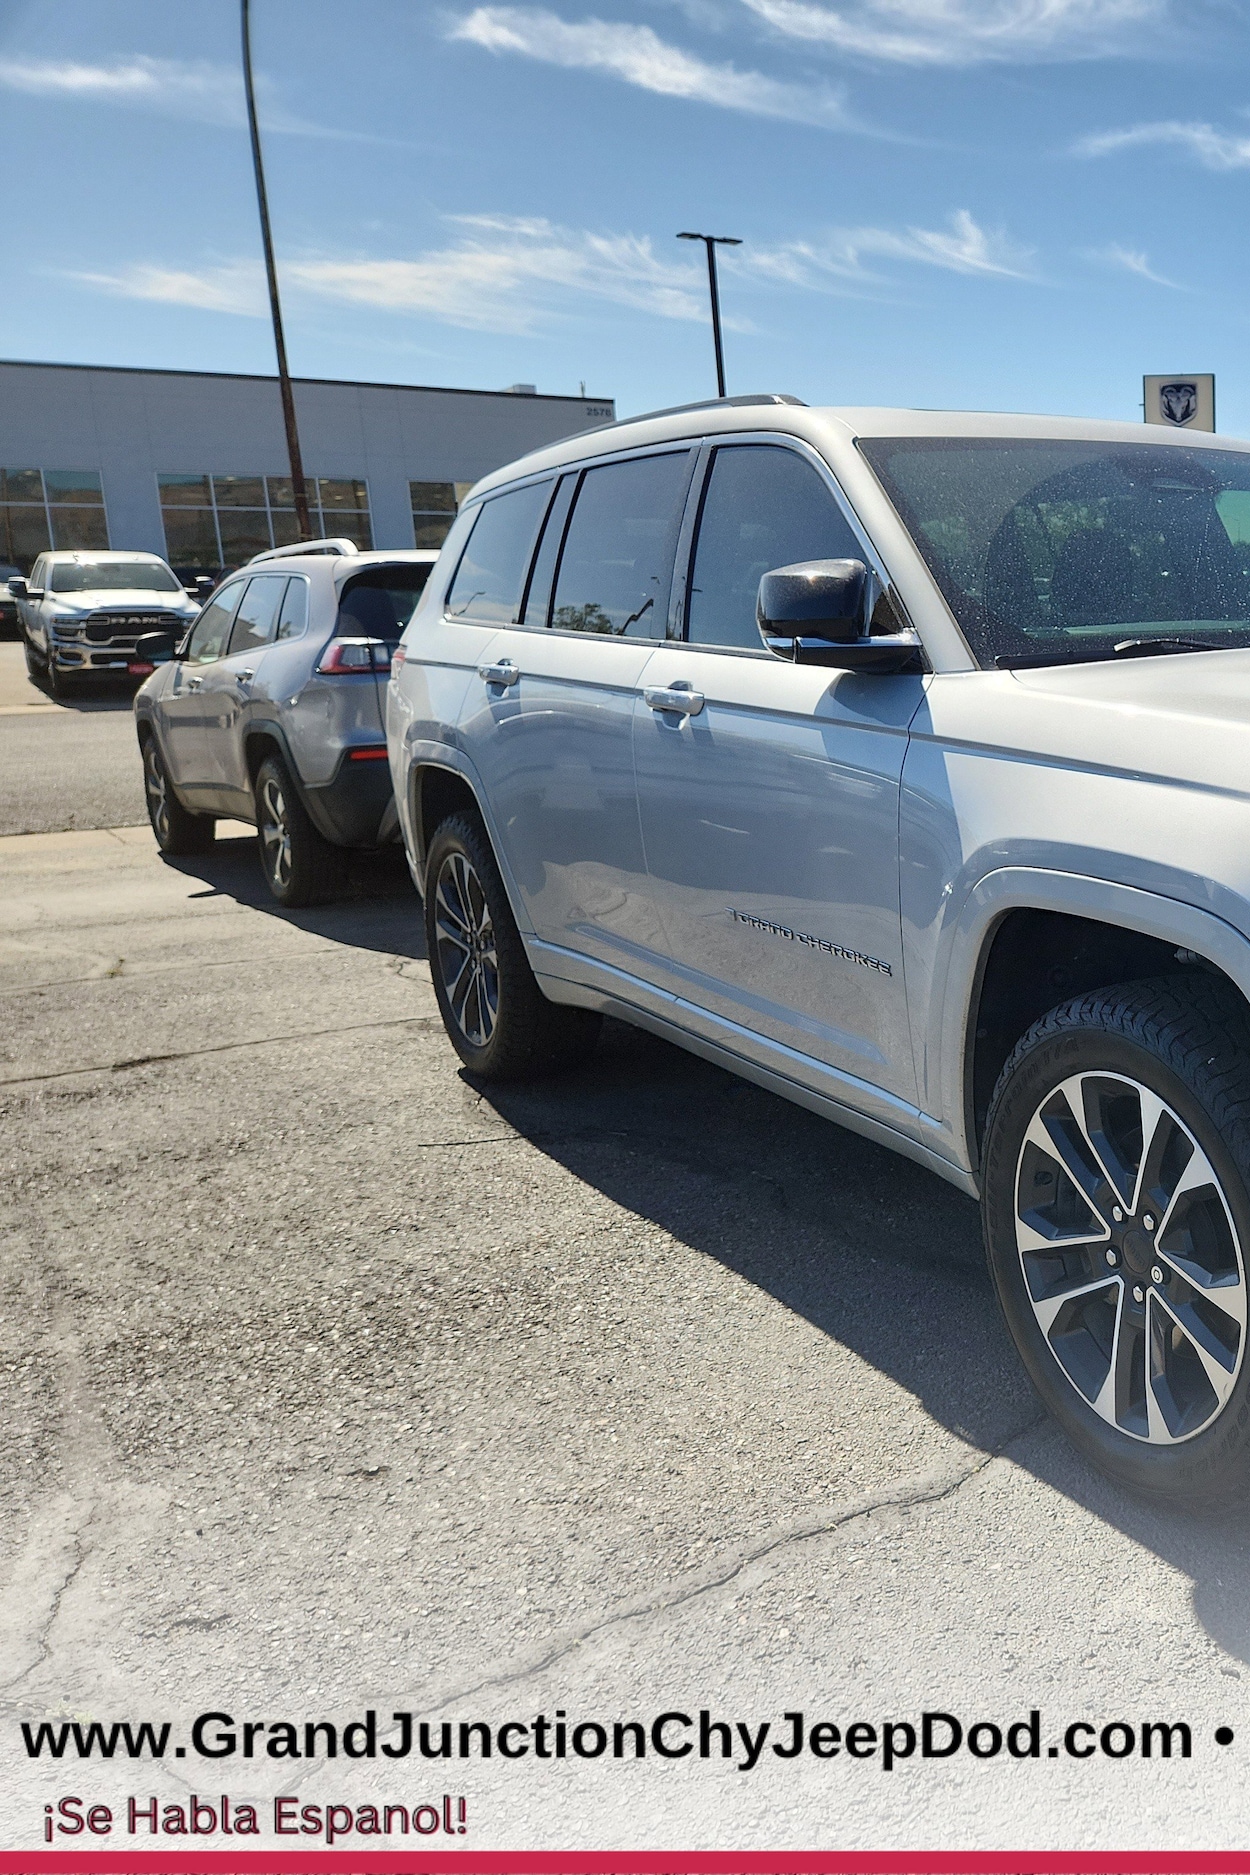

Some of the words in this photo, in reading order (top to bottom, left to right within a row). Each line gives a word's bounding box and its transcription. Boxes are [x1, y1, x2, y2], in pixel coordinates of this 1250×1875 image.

[110, 616, 158, 624] RAM
[738, 911, 794, 940] GRAND
[797, 932, 892, 977] CHEROKEE
